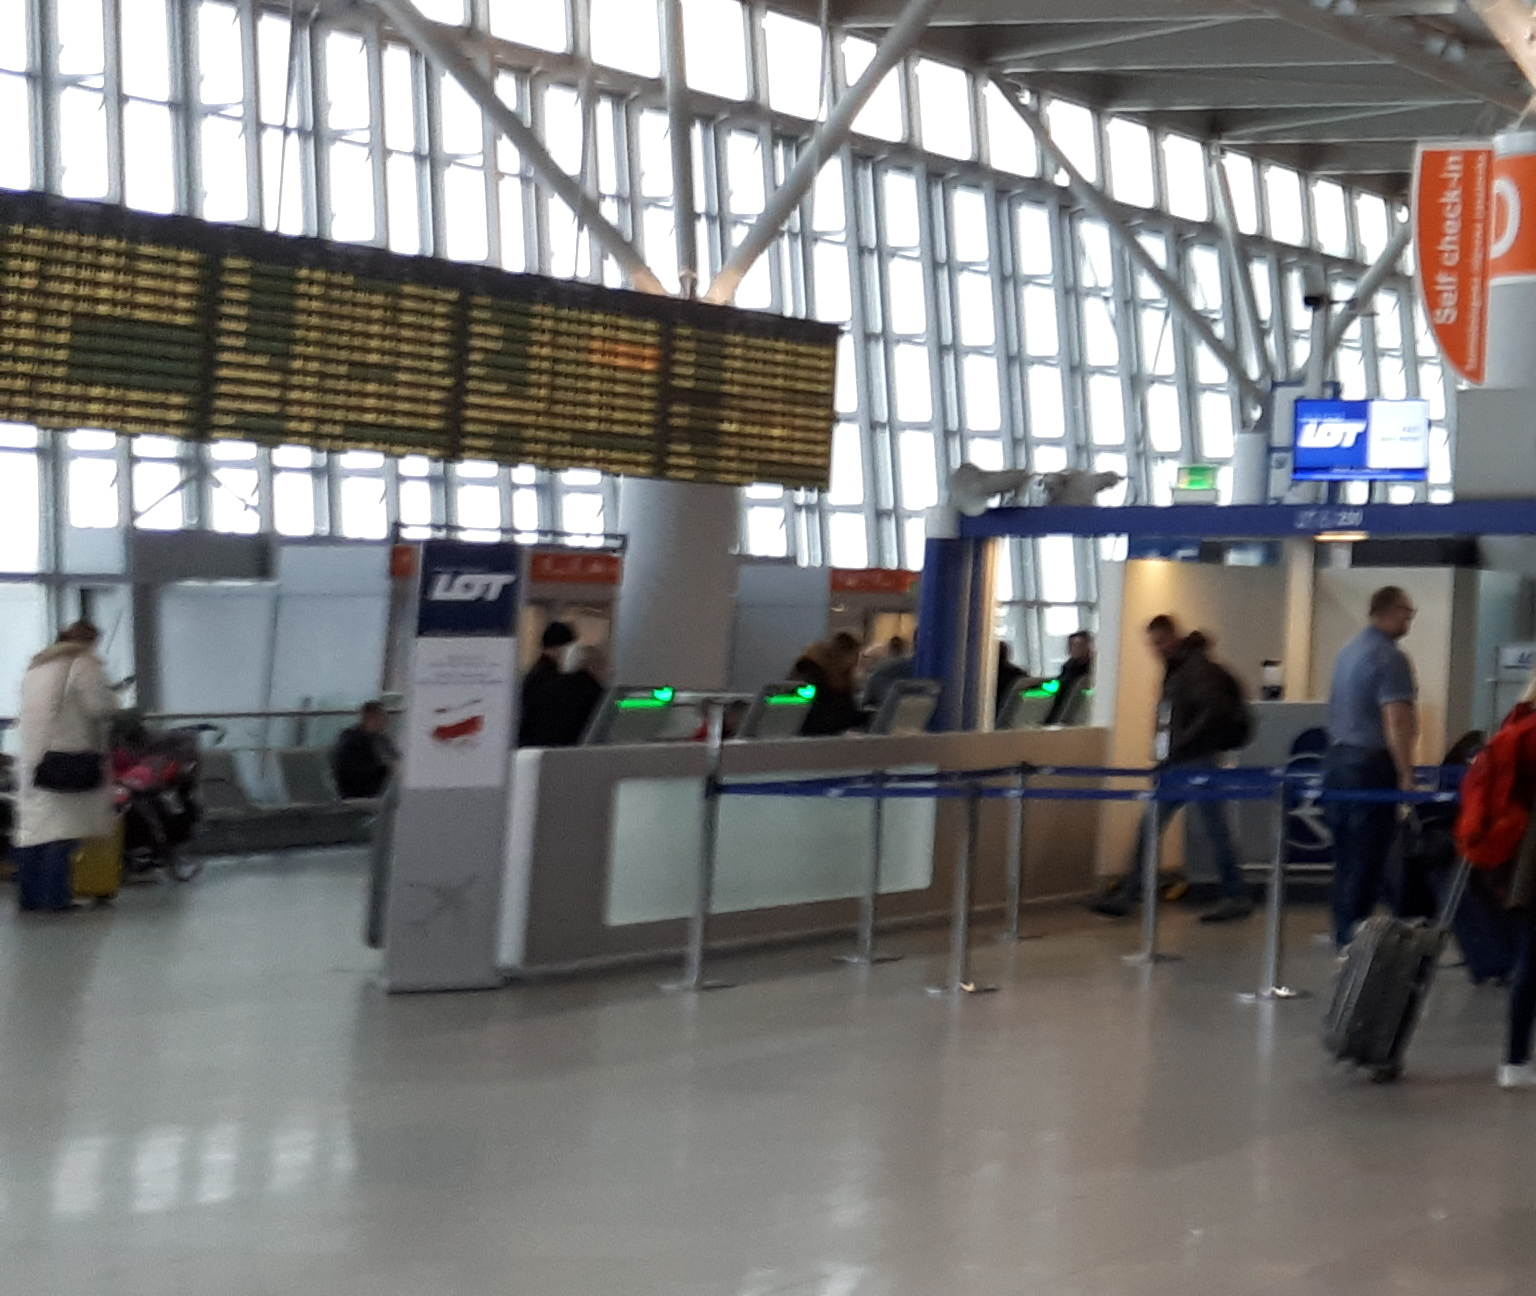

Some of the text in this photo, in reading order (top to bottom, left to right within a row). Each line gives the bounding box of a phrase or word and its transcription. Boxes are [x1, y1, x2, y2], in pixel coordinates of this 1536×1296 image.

[1434, 154, 1464, 325] Self check-in
[1297, 420, 1367, 448] LOT
[429, 572, 517, 602] LOT
